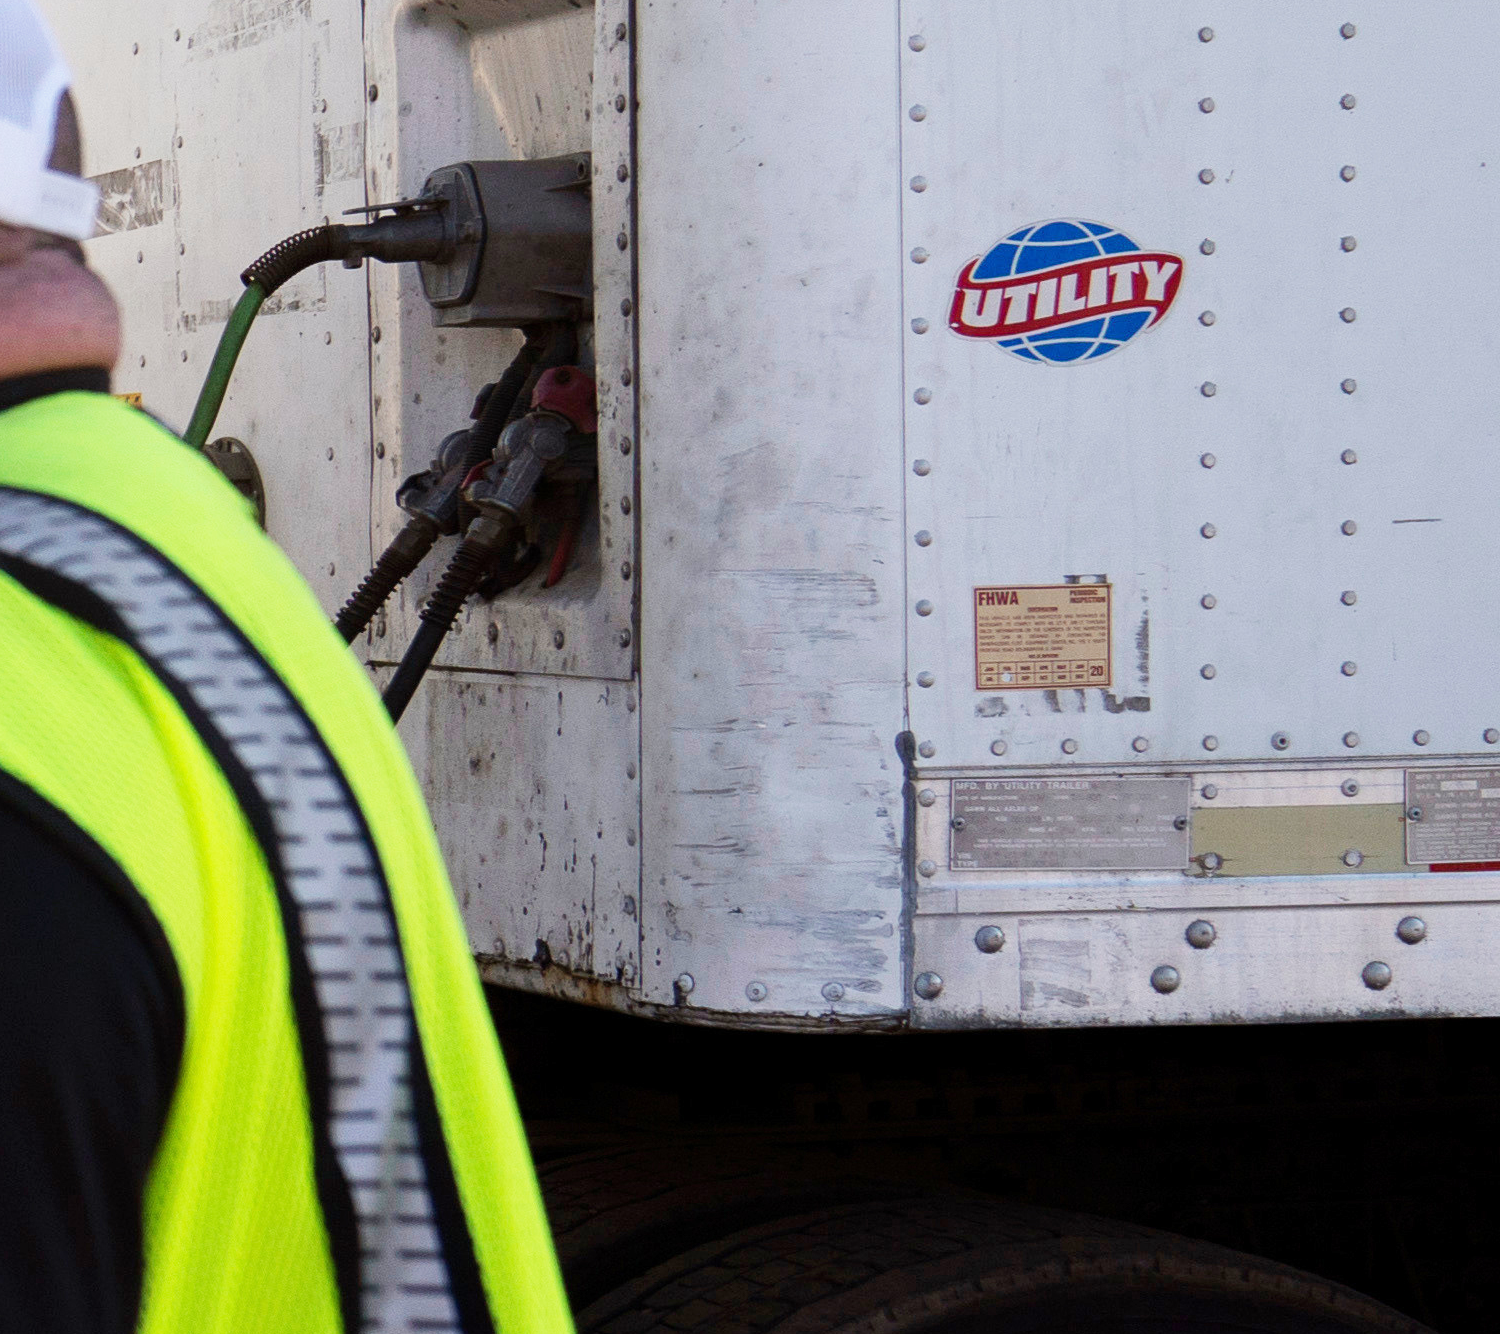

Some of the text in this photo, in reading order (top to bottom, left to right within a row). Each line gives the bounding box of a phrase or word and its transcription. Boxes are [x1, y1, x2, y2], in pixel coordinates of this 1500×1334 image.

[960, 261, 1179, 328] UTILITY
[978, 590, 1020, 606] FHWA
[1090, 665, 1104, 677] 20
[985, 781, 1000, 791] BY
[1046, 780, 1090, 790] TRAILER
